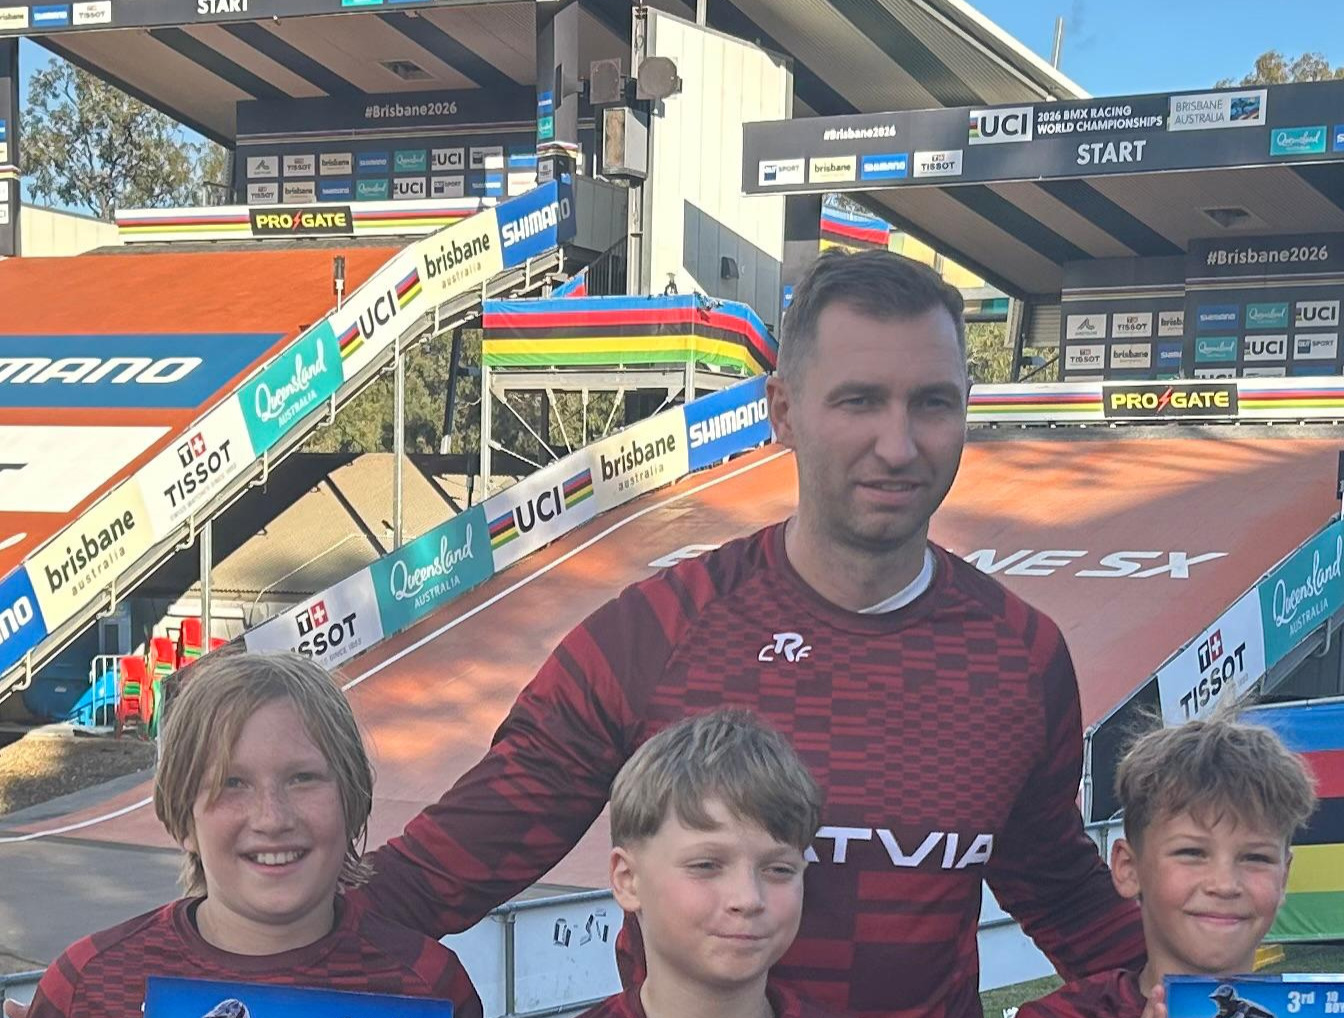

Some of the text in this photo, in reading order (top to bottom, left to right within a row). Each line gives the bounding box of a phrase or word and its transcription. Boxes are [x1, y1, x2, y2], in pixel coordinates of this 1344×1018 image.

[365, 102, 457, 118] #Brisbane2026
[1063, 109, 1088, 120] BMX
[1090, 106, 1132, 118] RACING
[1175, 99, 1223, 112] BRISBANE
[980, 113, 1028, 138] UCI
[1037, 116, 1163, 135] WORLD CHAMPIONSHIPS
[1174, 113, 1225, 125] AUSTRALIA
[438, 153, 462, 166] UCI
[1076, 140, 1147, 165] START
[815, 163, 851, 173] brisbane
[921, 162, 955, 171] TISSOT
[399, 181, 424, 195] UCI
[256, 211, 347, 230] PRO GATE
[502, 197, 570, 248] SHIMANO
[424, 232, 490, 280] brisbane
[1207, 246, 1329, 267] #Brisbane2026
[441, 261, 482, 288] australia
[358, 290, 397, 341] UCI
[1303, 306, 1336, 322] UCI
[1117, 323, 1148, 332] TISSOT
[1113, 350, 1149, 361] brisbane
[1251, 340, 1284, 355] UCI
[1312, 340, 1334, 348] SPORT
[1070, 354, 1100, 363] TISSOT
[255, 338, 327, 423] Queensland
[278, 390, 317, 429] AUSTRALIA
[1111, 391, 1230, 409] PRO GATE
[688, 396, 770, 448] SHIMANO
[600, 434, 676, 484] brisbane
[164, 438, 230, 508] TISSOT
[618, 462, 665, 491] australia
[516, 486, 562, 535] UCI
[44, 506, 135, 594] brisbane
[389, 523, 475, 602] Queensland
[71, 546, 126, 597] australia
[1075, 551, 1230, 579] SX
[414, 574, 461, 610] AUSTRALIA
[1272, 535, 1342, 627] Queensland
[1288, 599, 1329, 638] AUSTRALIA
[291, 612, 357, 661] SSOT
[1180, 641, 1246, 720] TISSOT
[803, 826, 994, 869] TVIA
[1287, 991, 1339, 1013] 3rd 10
